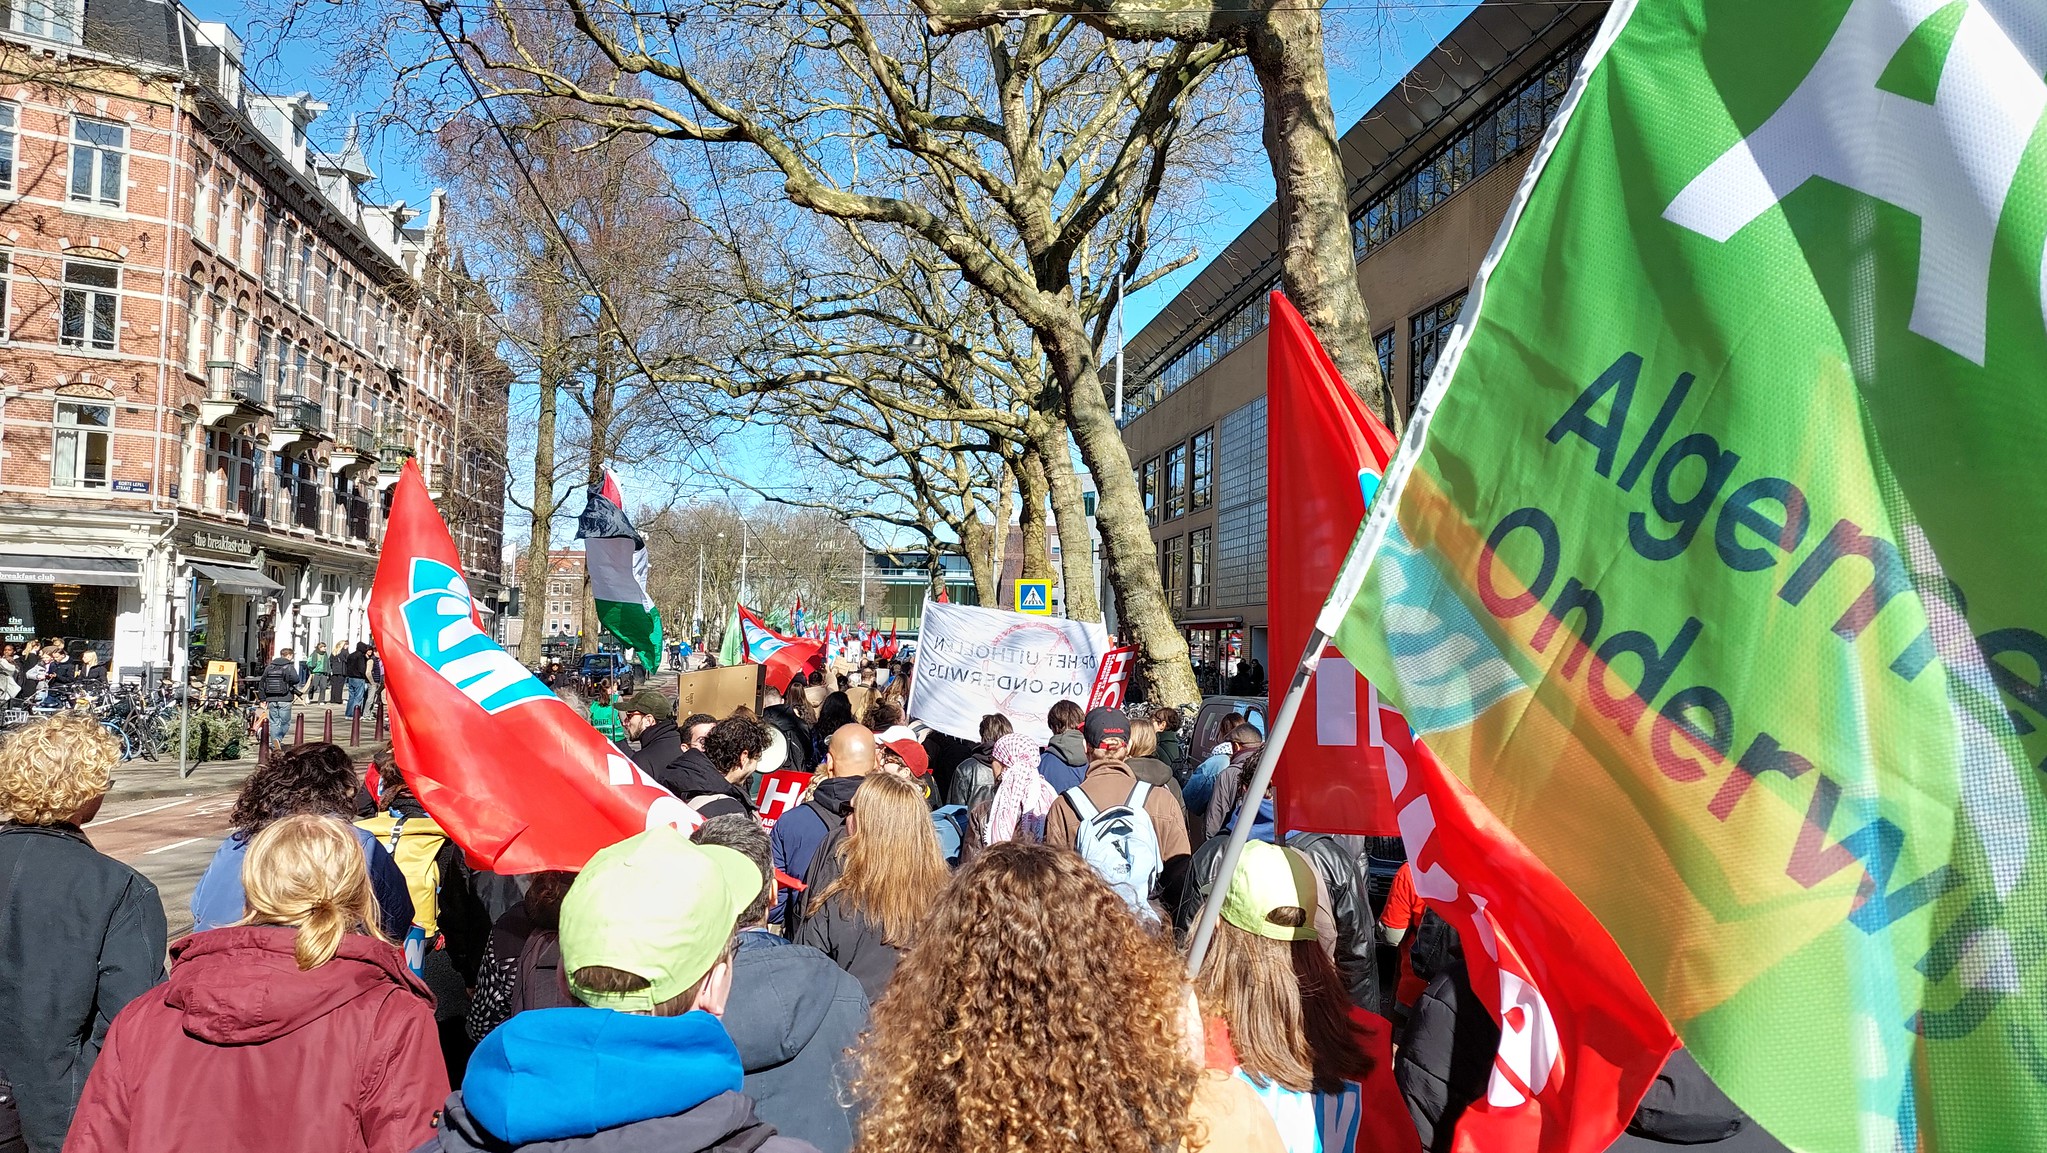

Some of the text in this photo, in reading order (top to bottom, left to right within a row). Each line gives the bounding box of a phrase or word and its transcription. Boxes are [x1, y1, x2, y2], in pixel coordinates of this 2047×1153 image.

[194, 531, 252, 554] the breakfast club
